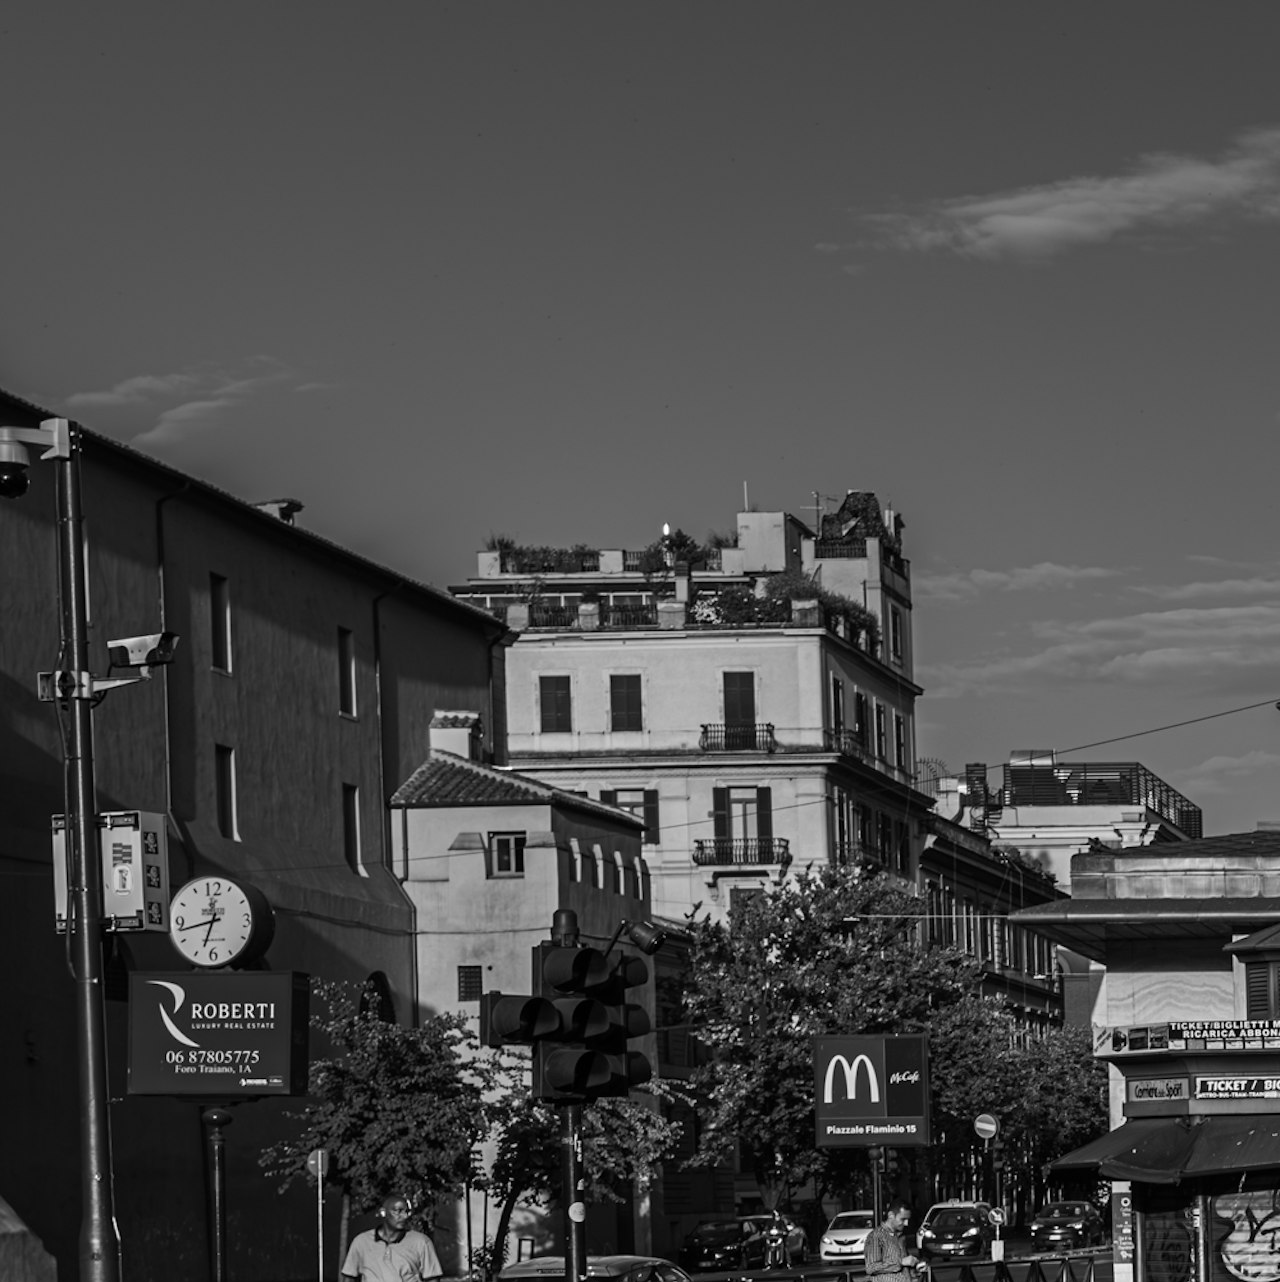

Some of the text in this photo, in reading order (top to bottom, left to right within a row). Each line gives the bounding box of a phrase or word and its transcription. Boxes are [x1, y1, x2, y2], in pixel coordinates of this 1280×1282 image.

[205, 881, 221, 897] 12
[175, 913, 251, 931] 9 3
[208, 947, 218, 961] 6
[191, 1003, 275, 1019] ROBERTI
[1171, 1020, 1269, 1031] TICKET/BIGLIETTI
[1183, 1028, 1236, 1039] RICARICA
[165, 1050, 260, 1064] 06 87805775
[174, 1064, 197, 1074] Foro
[238, 1064, 252, 1074] 1A
[1206, 1080, 1248, 1092] TICKET
[826, 1124, 917, 1136] Piazzale Flaminio 15
